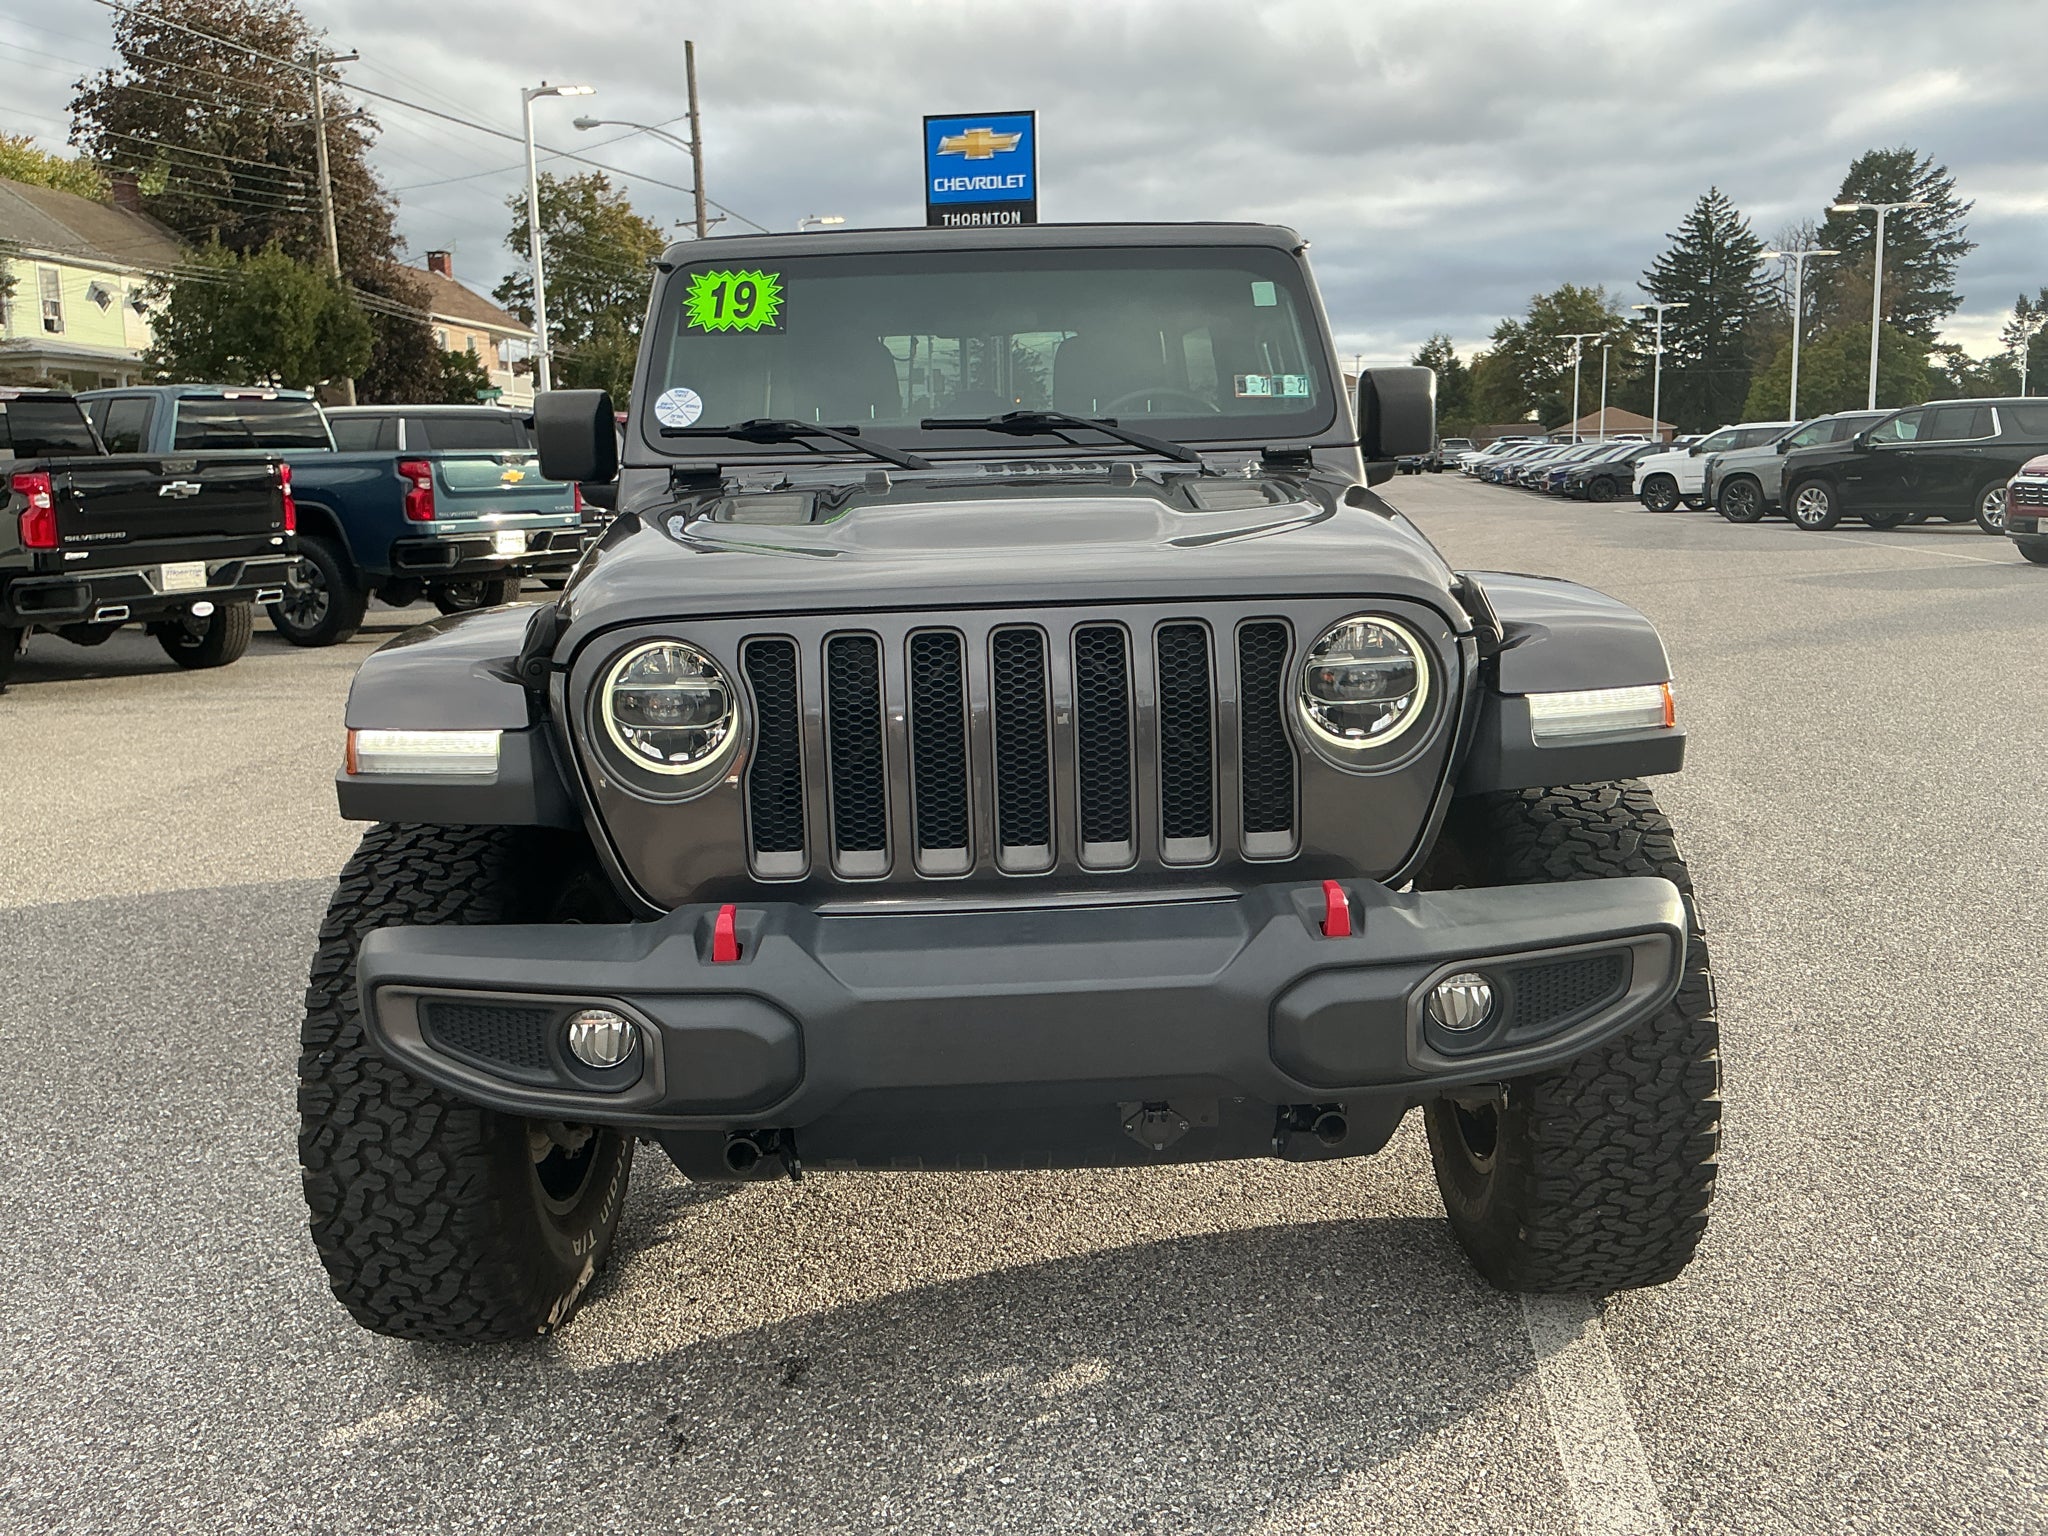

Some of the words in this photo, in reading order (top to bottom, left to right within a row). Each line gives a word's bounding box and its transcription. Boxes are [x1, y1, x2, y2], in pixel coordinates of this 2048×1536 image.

[933, 174, 1026, 192] CHEVROLET
[942, 211, 1021, 226] THORNTON
[711, 280, 757, 320] 19
[64, 531, 126, 542] SILVERADO
